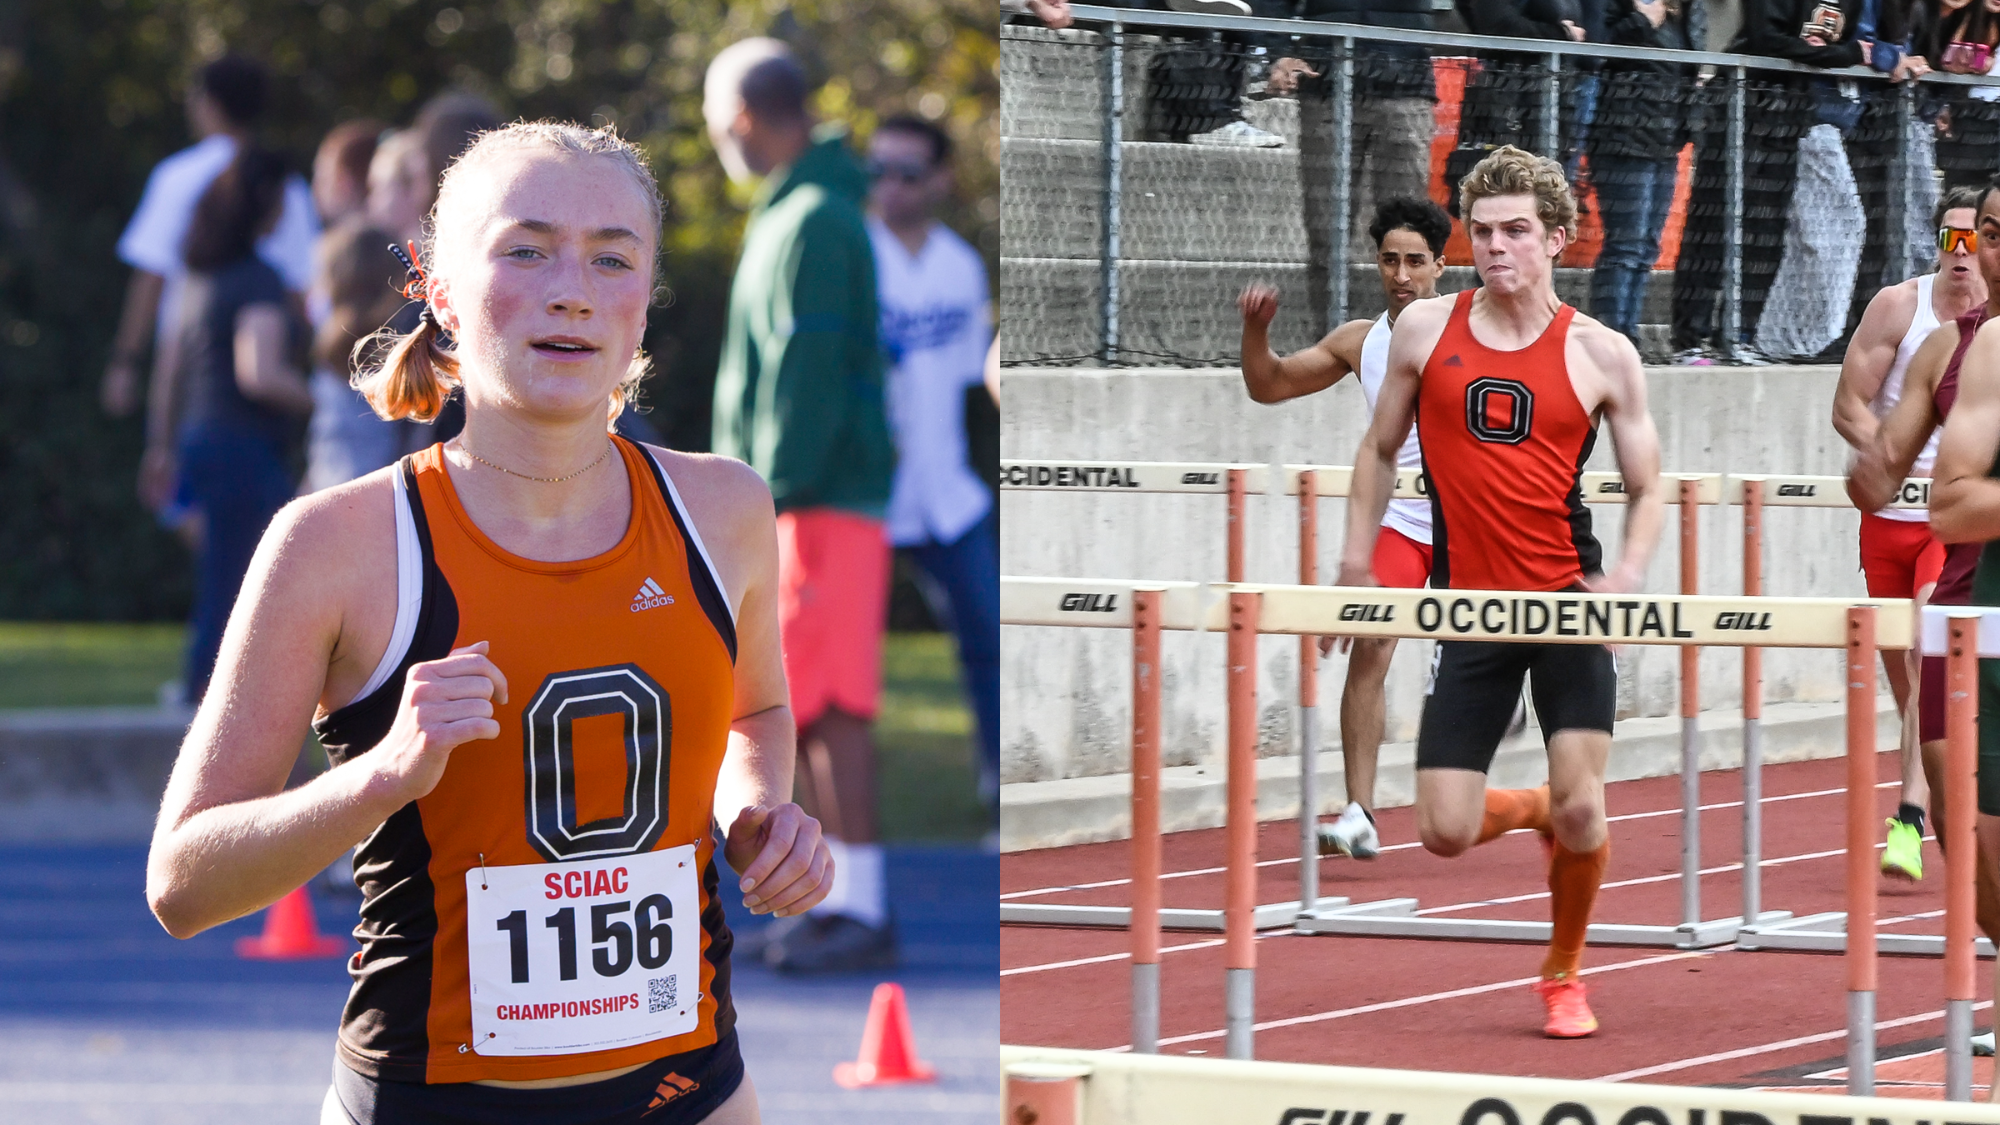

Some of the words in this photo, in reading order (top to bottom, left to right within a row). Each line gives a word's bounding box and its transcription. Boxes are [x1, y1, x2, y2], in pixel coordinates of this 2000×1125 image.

[1465, 376, 1534, 446] O
[630, 595, 675, 613] adidas
[1059, 593, 1118, 612] GILL
[1338, 604, 1396, 622] GILL
[1416, 597, 1694, 638] OCCIDENTAL
[1714, 611, 1773, 630] GILL
[544, 867, 628, 900] SCIAC
[496, 893, 673, 984] 1156
[496, 993, 639, 1020] CHAMPIONSHIPS
